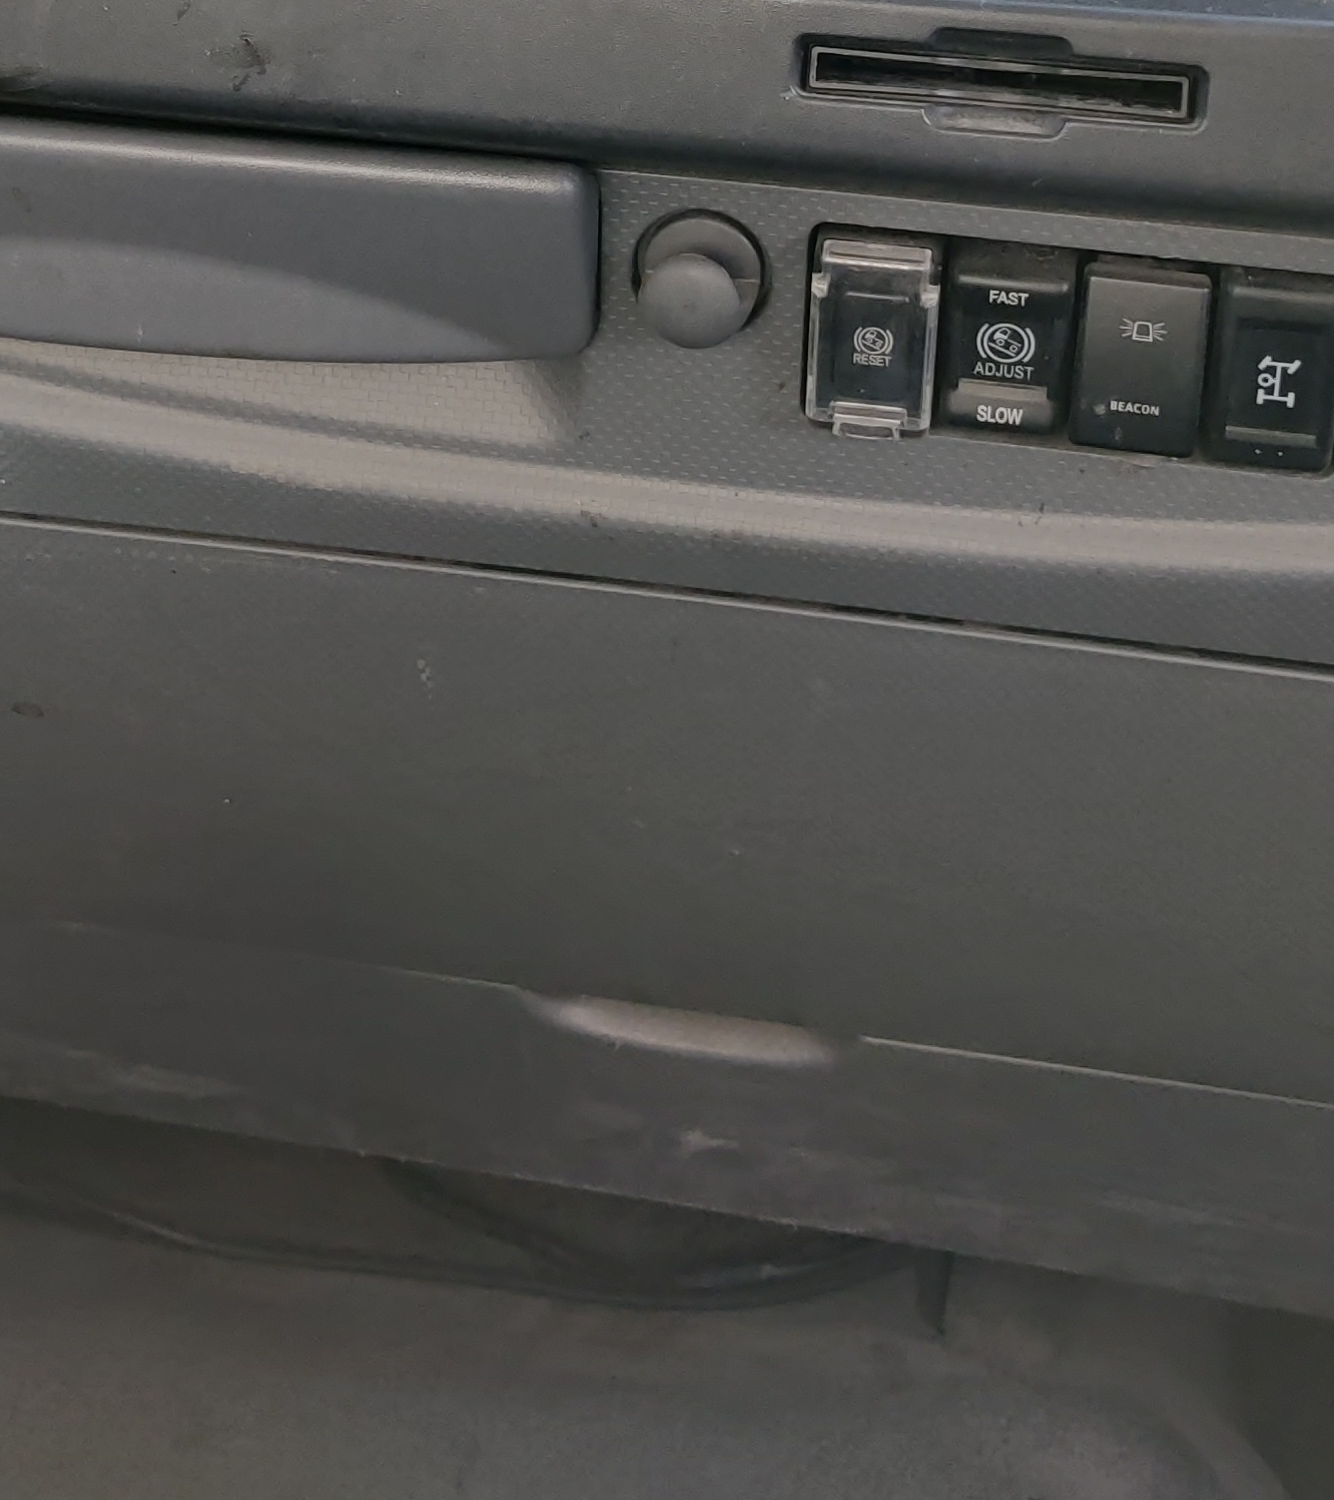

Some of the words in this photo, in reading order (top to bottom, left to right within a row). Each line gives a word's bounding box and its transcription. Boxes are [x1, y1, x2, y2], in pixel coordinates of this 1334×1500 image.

[989, 290, 1029, 307] FAST
[853, 353, 892, 367] RESET
[973, 361, 1035, 380] ADJUST
[976, 404, 1023, 426] SLOW
[1110, 400, 1160, 417] BEACON
